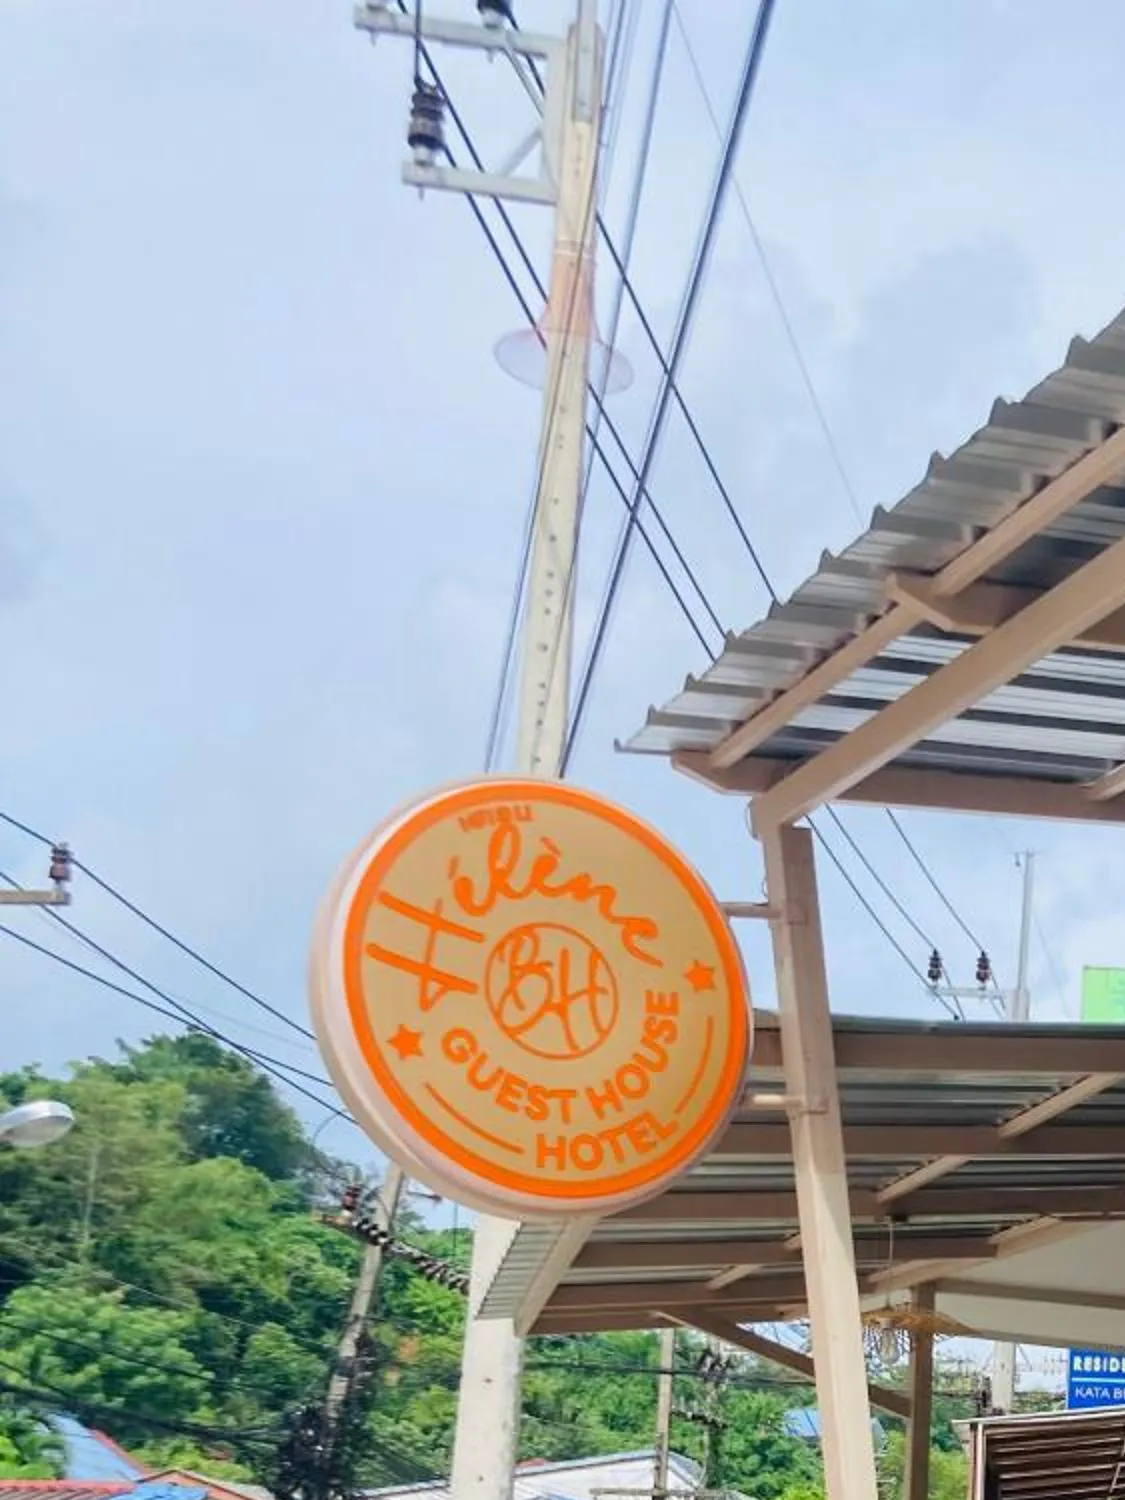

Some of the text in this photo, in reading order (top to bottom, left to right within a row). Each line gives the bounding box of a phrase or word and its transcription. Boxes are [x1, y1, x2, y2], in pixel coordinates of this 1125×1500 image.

[365, 822, 664, 1011] Hélène
[441, 988, 680, 1124] GUEST HOUSE
[536, 1110, 680, 1170] HOTEL
[1075, 1386, 1110, 1400] KATA
